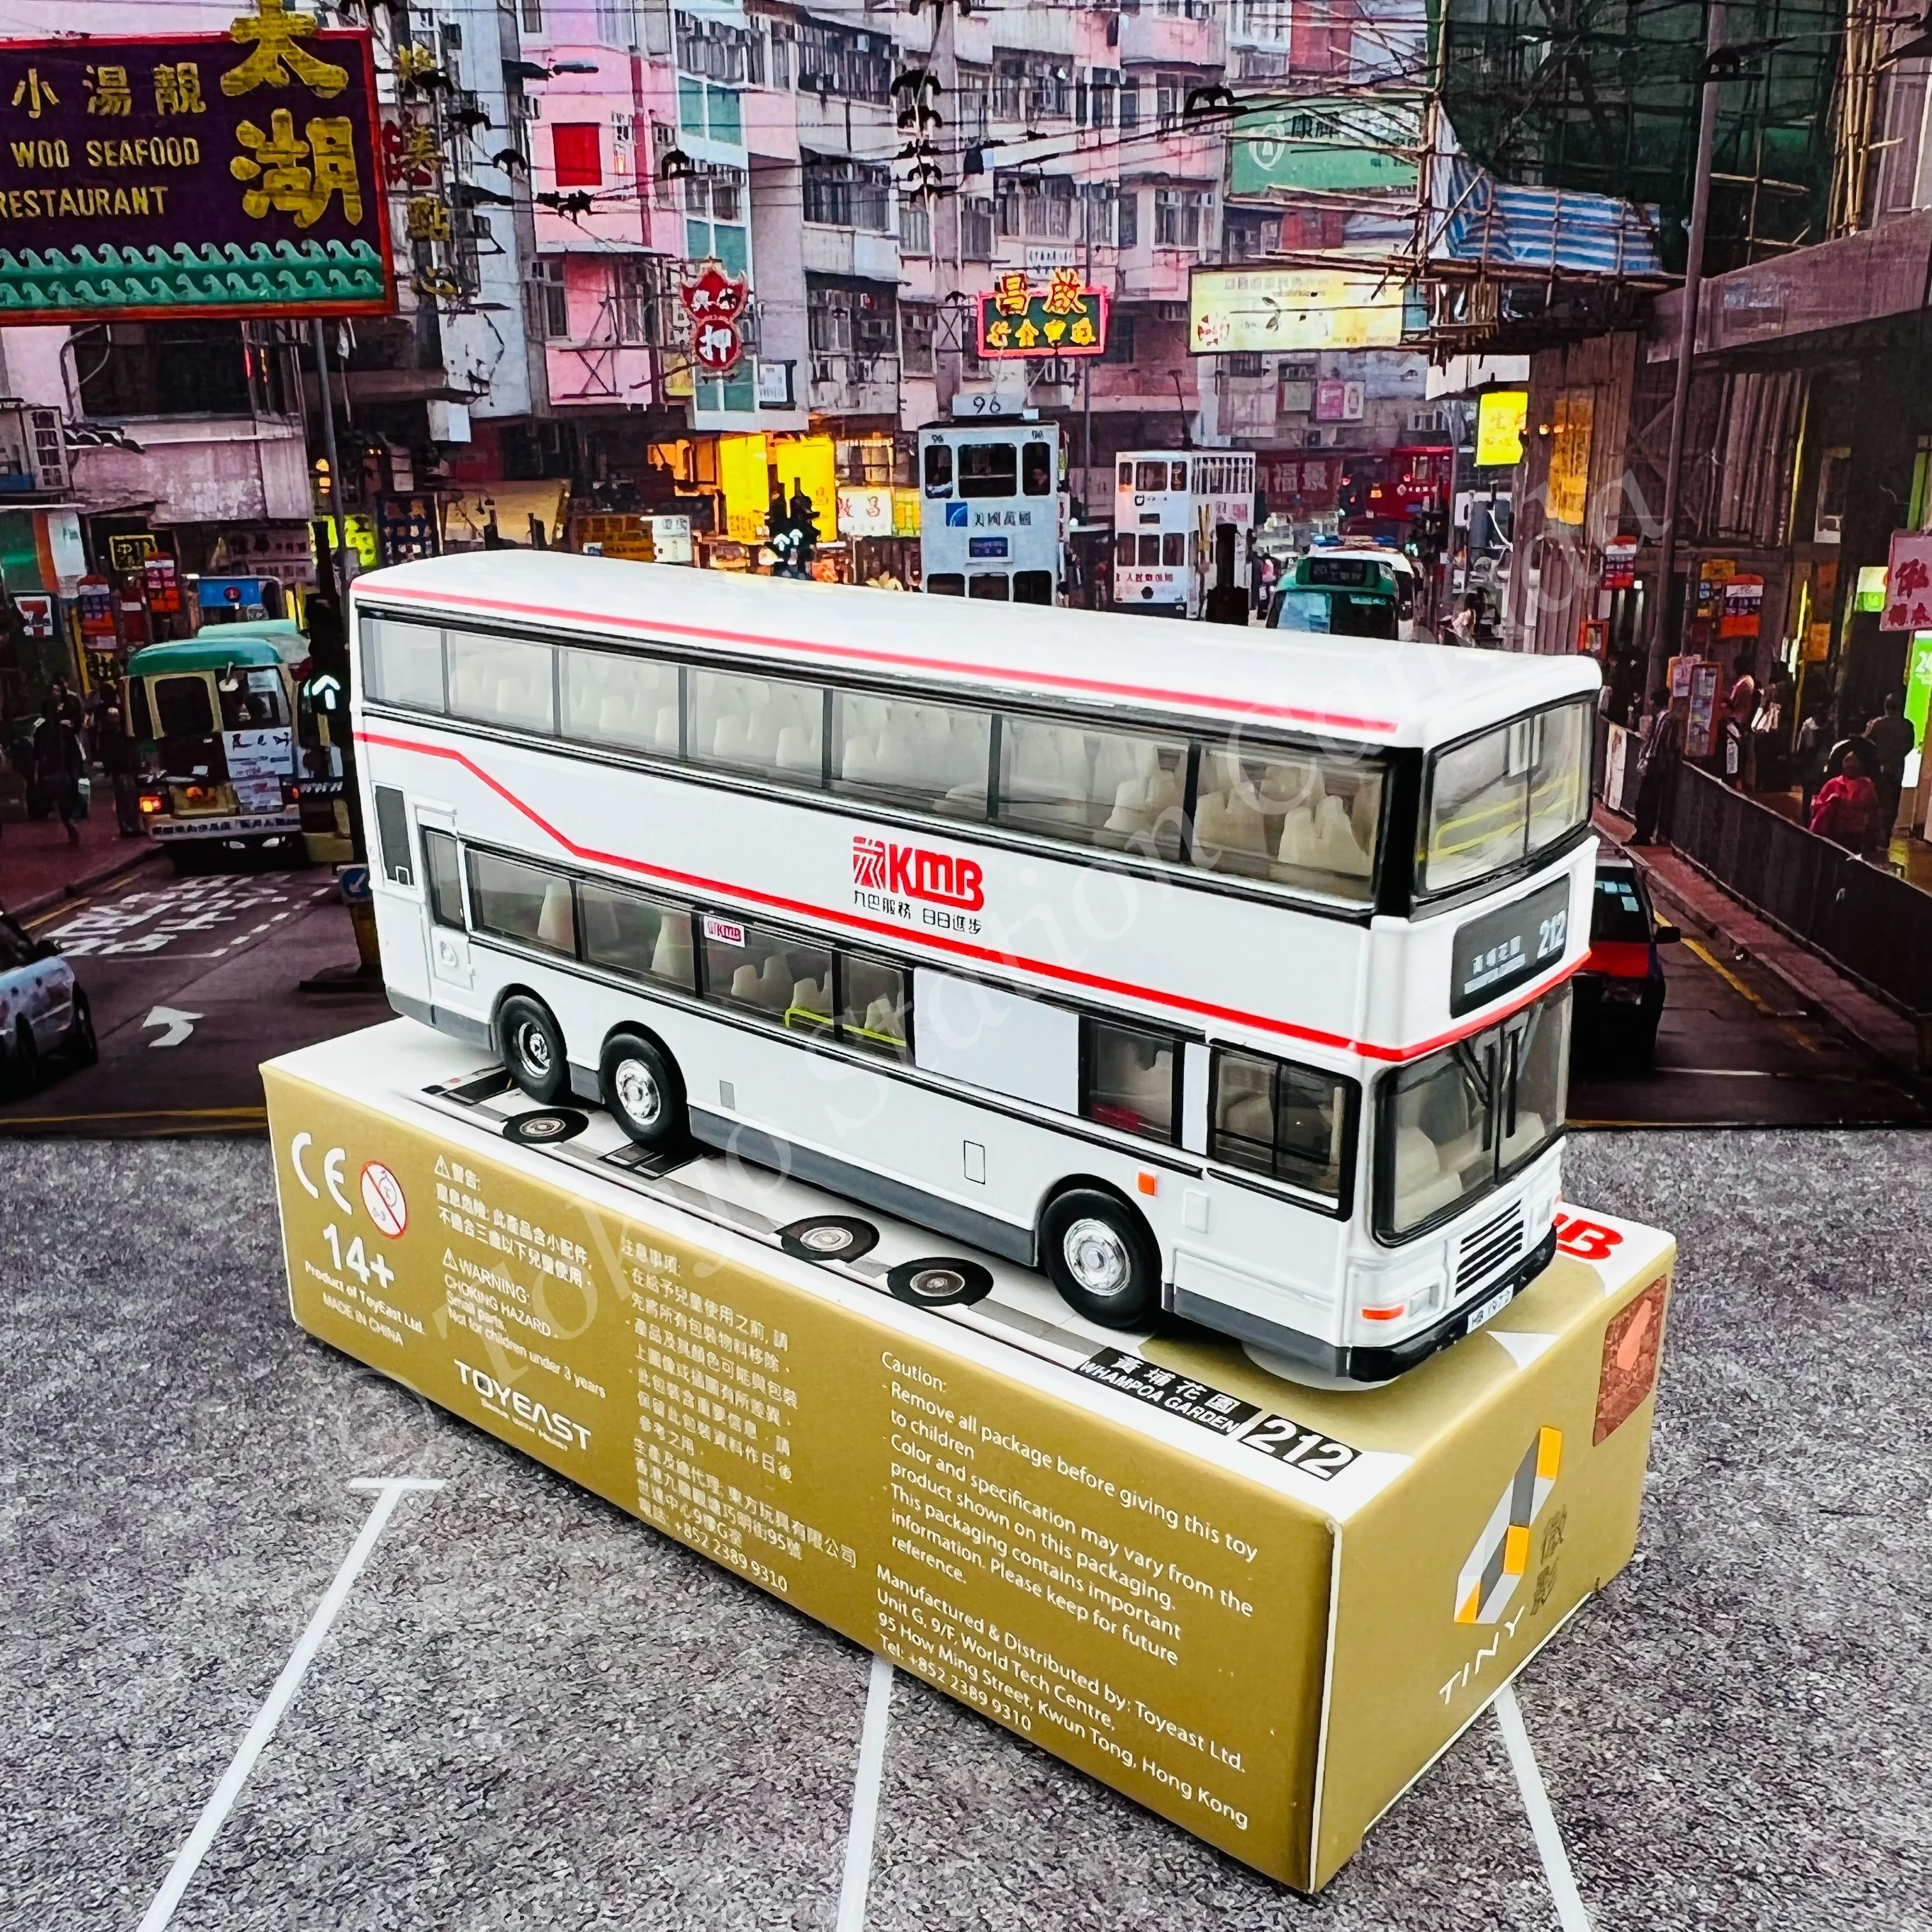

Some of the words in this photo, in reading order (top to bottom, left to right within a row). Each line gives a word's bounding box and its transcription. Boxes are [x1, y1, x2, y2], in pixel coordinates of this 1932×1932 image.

[10, 138, 70, 168] WOO
[86, 136, 200, 167] SEAFOOD
[0, 186, 169, 218] RESTAURANT
[973, 395, 1001, 415] 96
[889, 843, 985, 912] KMB
[1537, 909, 1566, 959] 212
[323, 1223, 395, 1289] 14+
[459, 1258, 530, 1303] WARNING:
[445, 1273, 498, 1311] CHOKING
[574, 1374, 606, 1399] years
[882, 1351, 947, 1393] Caution:
[1078, 1361, 1164, 1403] WHAMPOA
[1164, 1397, 1241, 1434] GARDEN
[891, 1409, 907, 1428] to
[910, 1419, 974, 1460] children
[1241, 1418, 1354, 1480] 212
[891, 1381, 954, 1423] Remove
[958, 1414, 977, 1434] all
[981, 1426, 1052, 1469] package
[1057, 1455, 1115, 1497] before
[1120, 1489, 1178, 1529] giving
[1184, 1514, 1220, 1544] this
[1225, 1533, 1258, 1563] toy
[891, 1434, 933, 1465] Color
[935, 1458, 966, 1482] and
[970, 1475, 1076, 1535] specification
[1081, 1526, 1119, 1557] may
[1124, 1546, 1164, 1578] vary
[1169, 1563, 1213, 1599] from
[1220, 1590, 1254, 1618] the
[891, 1462, 953, 1502] product
[956, 1492, 1010, 1530] shown
[1014, 1522, 1036, 1542] on
[1041, 1532, 1072, 1560] this
[1077, 1552, 1176, 1611] packaging.
[713, 1538, 747, 1570] 2389
[751, 1560, 788, 1593] 9310
[890, 1482, 921, 1511] This
[925, 1503, 1008, 1558] packaging
[1012, 1547, 1084, 1592] contains
[1089, 1580, 1181, 1641] important
[892, 1536, 967, 1584] reference.
[990, 1557, 1043, 1598] Please
[1047, 1585, 1089, 1621] keep
[1093, 1609, 1117, 1634] for
[1122, 1623, 1178, 1667] future
[877, 1587, 908, 1618] Unit
[961, 1632, 1008, 1671] World
[1011, 1659, 1050, 1695] Tech
[1054, 1685, 1115, 1731] Centre,
[877, 1563, 985, 1634] Manufactured
[988, 1623, 1000, 1642] &
[1004, 1632, 1099, 1696] Distributed
[1104, 1683, 1131, 1712] by:
[1135, 1700, 1204, 1752] Toyeast
[1210, 1740, 1245, 1774] Ltd.
[879, 1633, 904, 1660] Tel:
[908, 1654, 946, 1684] +852
[950, 1675, 988, 1706] 2389
[992, 1698, 1031, 1731] 9310
[1438, 1604, 1525, 1705] TINY
[878, 1612, 896, 1632] 95
[900, 1623, 935, 1654] How
[939, 1644, 978, 1682] Ming
[982, 1668, 1034, 1712] Street,
[1038, 1699, 1085, 1738] Kwun
[1089, 1726, 1137, 1768] Tong,
[1142, 1756, 1192, 1800] Hong
[1198, 1786, 1248, 1831] Kong
